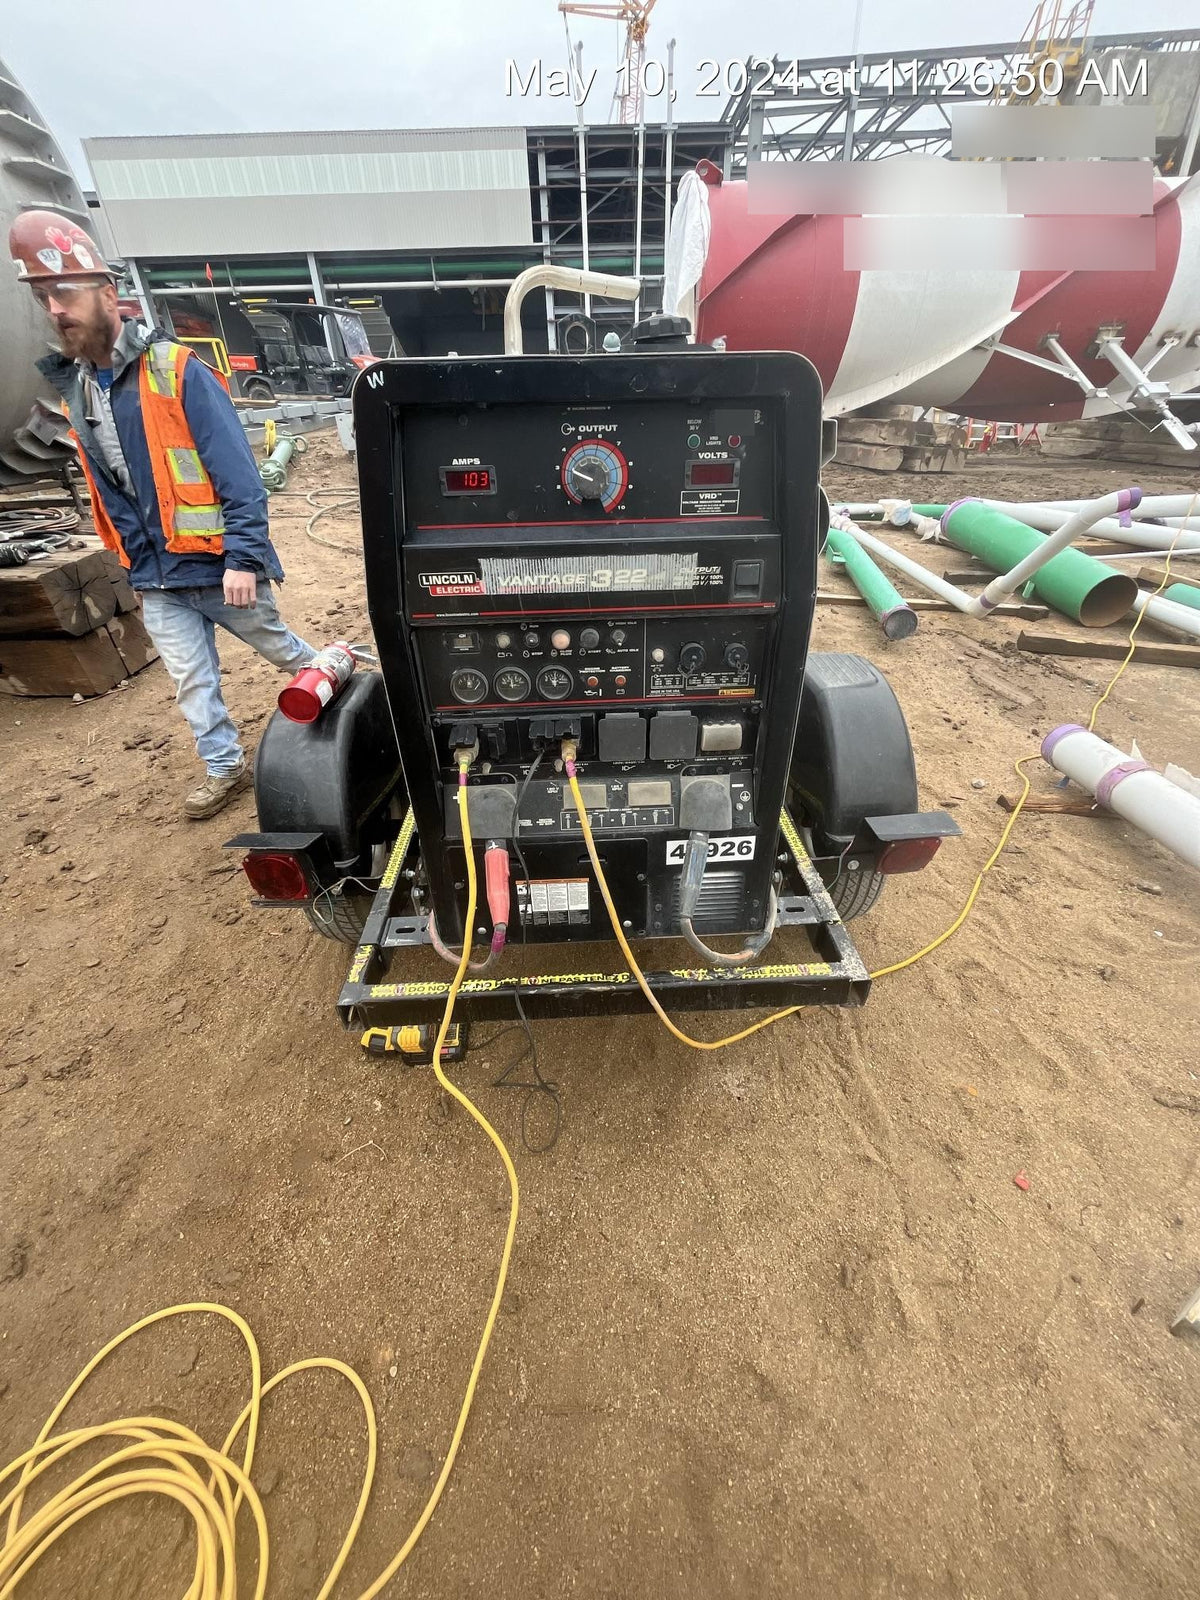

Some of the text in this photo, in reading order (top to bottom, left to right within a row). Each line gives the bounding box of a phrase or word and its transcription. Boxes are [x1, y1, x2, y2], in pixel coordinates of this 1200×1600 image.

[366, 370, 384, 389] W
[578, 424, 618, 432] OUTPUT
[698, 451, 728, 459] VOLTS
[465, 472, 488, 486] 103
[422, 574, 474, 585] LINCOLN
[498, 573, 588, 586] VANTAGE
[436, 586, 480, 594] ELECTRIC
[670, 840, 753, 859] 4926
[769, 967, 795, 975] AQUI
